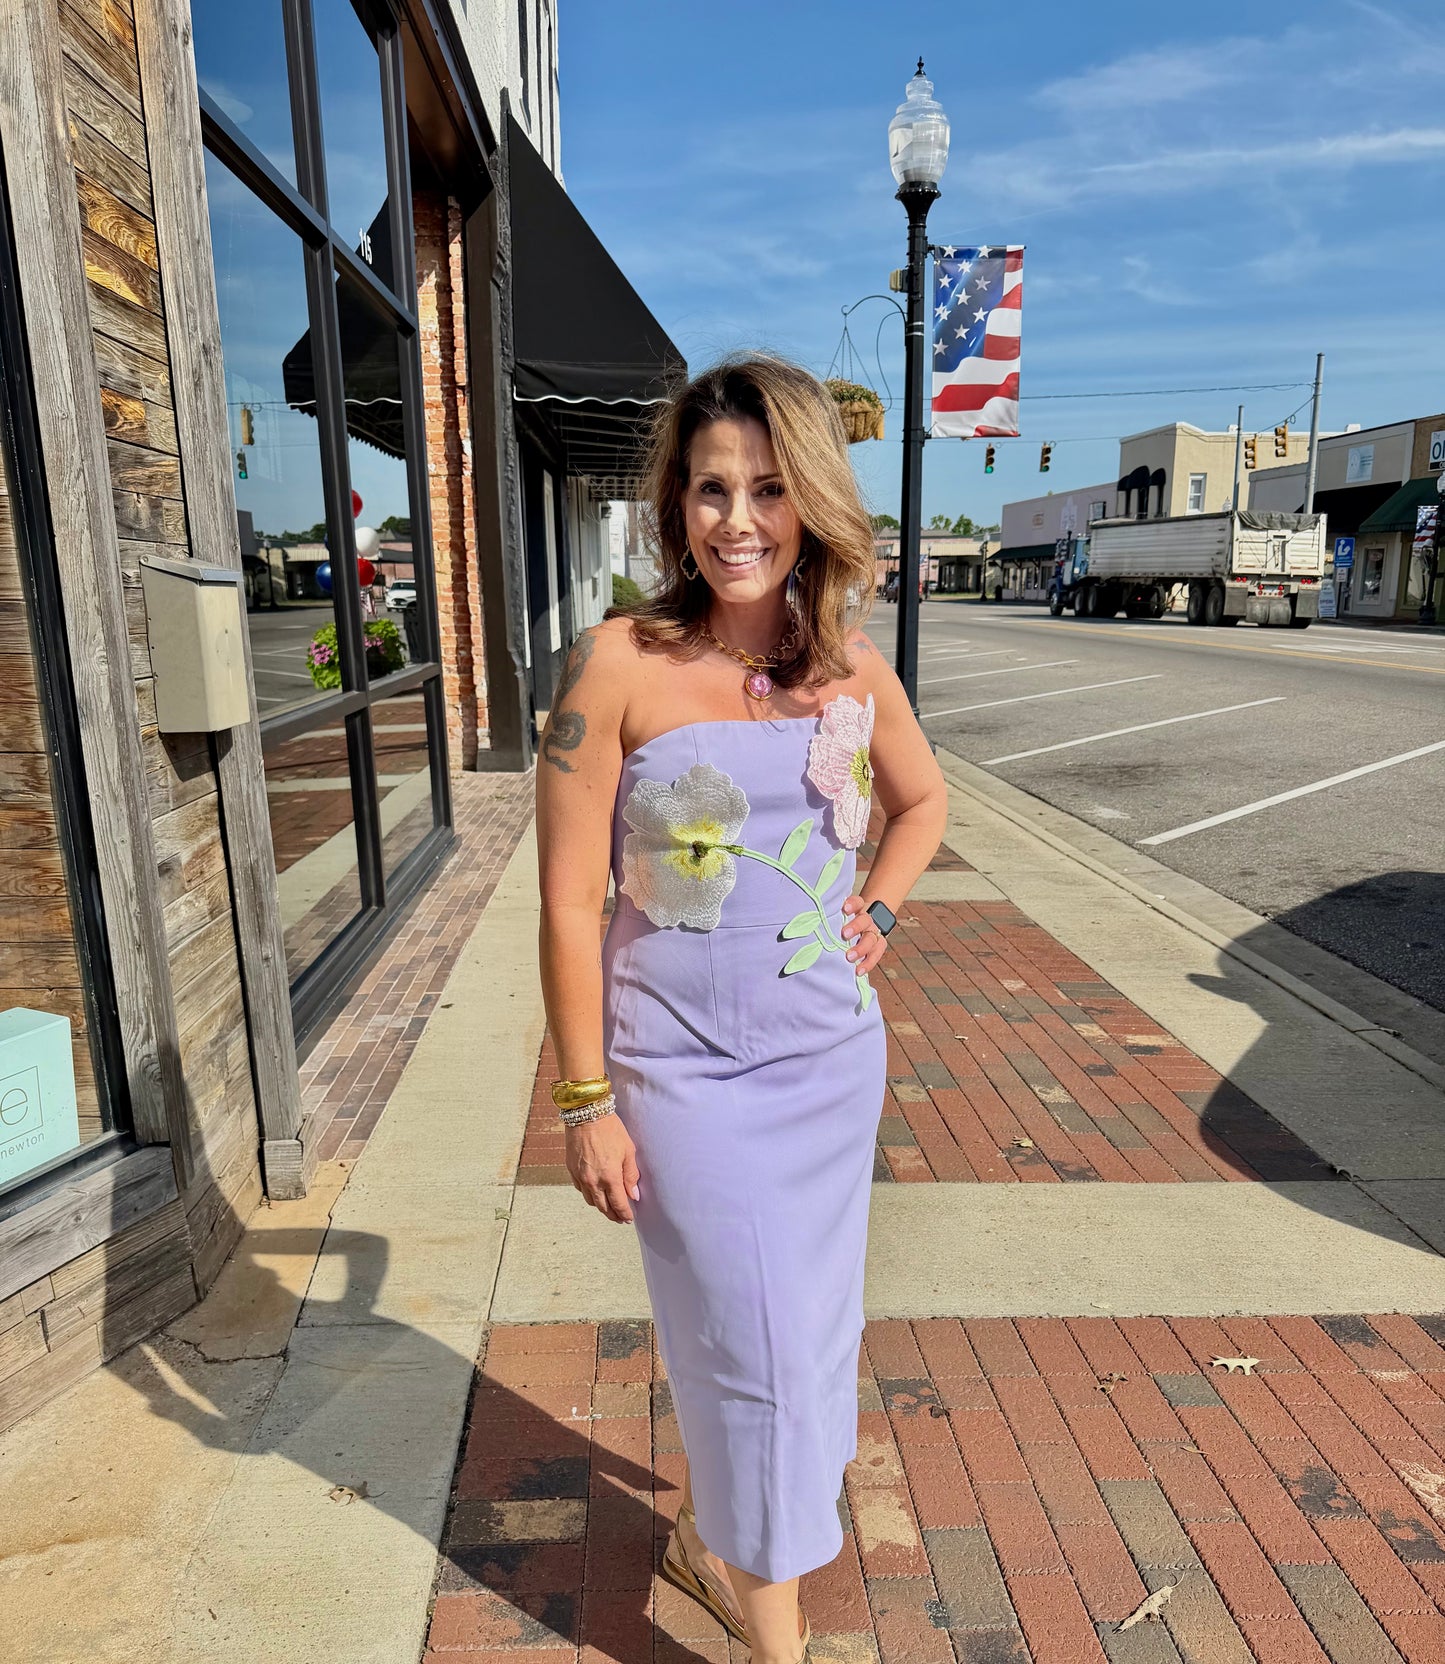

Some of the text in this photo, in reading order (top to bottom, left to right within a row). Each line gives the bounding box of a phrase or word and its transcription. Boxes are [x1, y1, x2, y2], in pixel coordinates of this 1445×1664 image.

[359, 228, 372, 264] 115
[0, 1088, 28, 1126] e
[0, 1132, 45, 1160] newton
